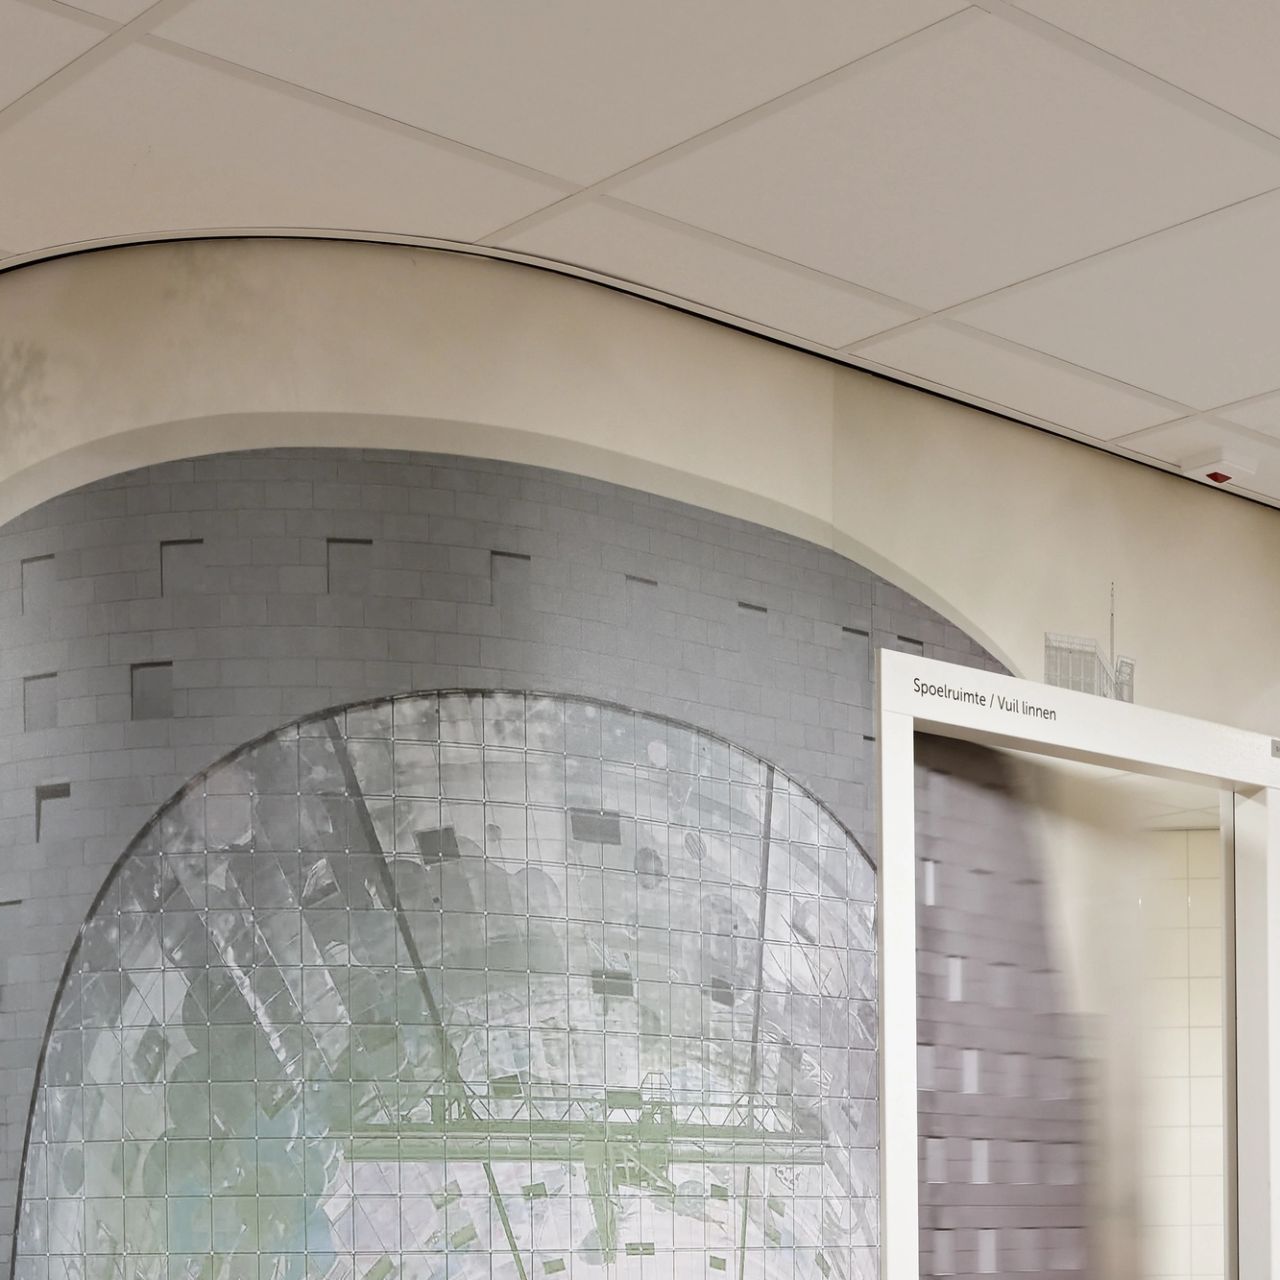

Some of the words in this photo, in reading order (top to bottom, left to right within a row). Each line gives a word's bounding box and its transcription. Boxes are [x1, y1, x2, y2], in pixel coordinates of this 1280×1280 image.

[913, 677, 986, 706] Spoelruimte
[989, 694, 995, 709] /
[998, 695, 1019, 714] Vuil
[1022, 701, 1056, 721] linnen
